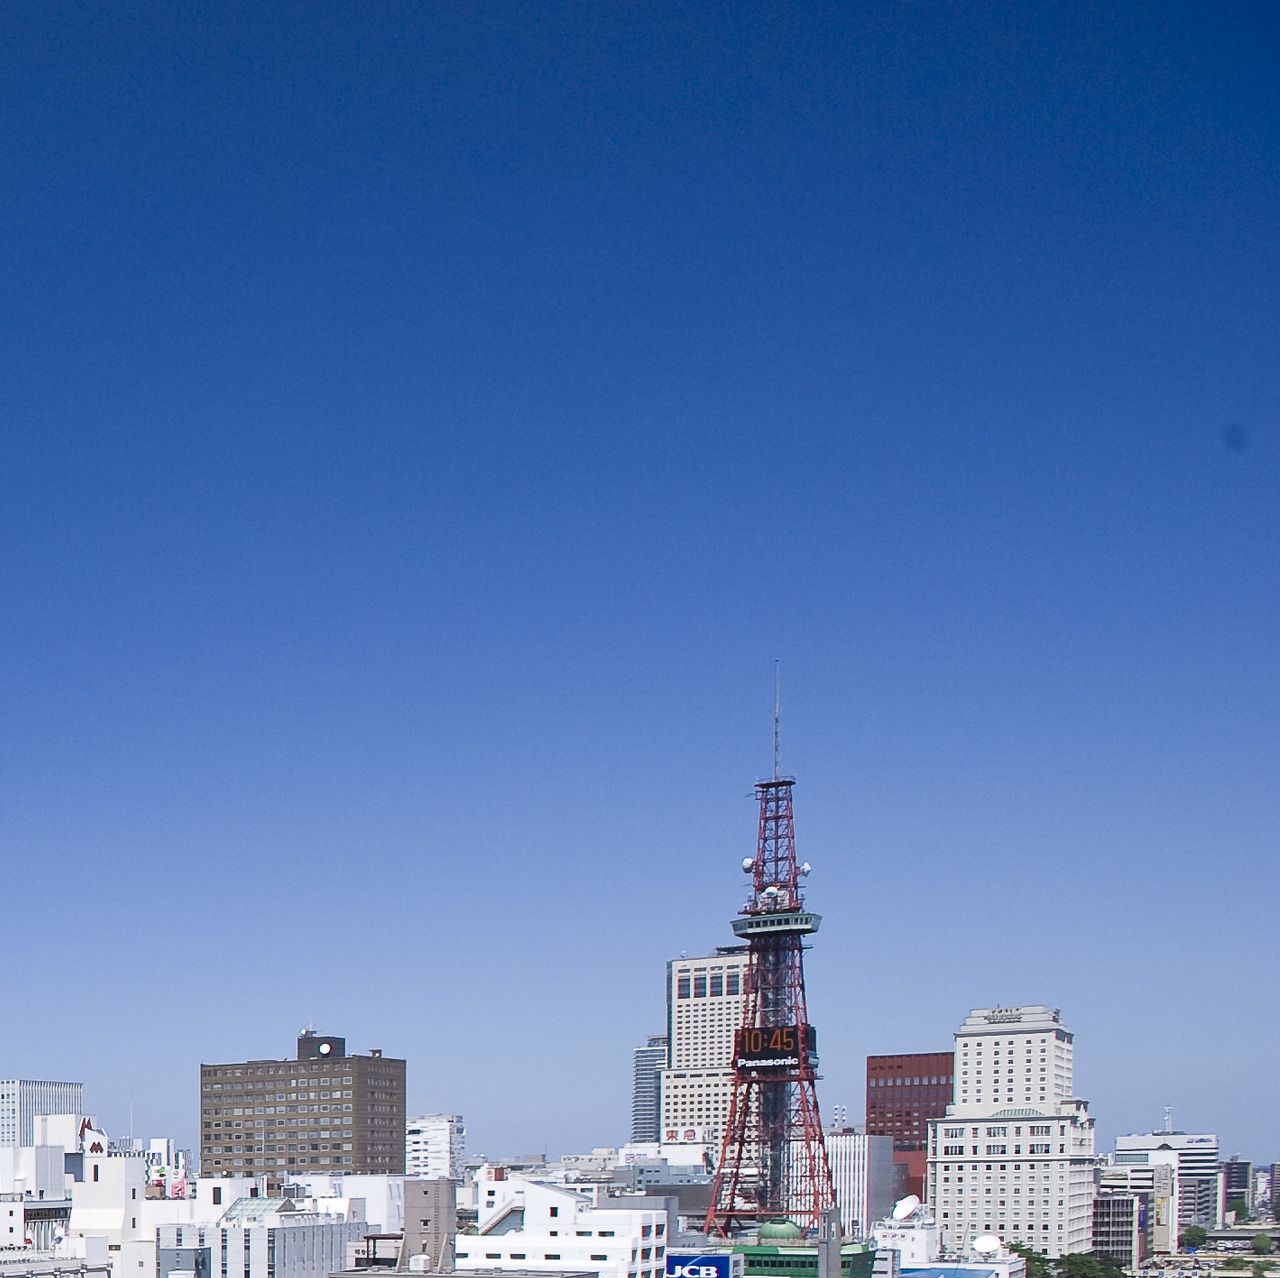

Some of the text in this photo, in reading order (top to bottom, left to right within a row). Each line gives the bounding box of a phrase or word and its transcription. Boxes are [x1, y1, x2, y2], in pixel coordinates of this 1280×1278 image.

[743, 1028, 794, 1053] 10:45
[737, 1056, 799, 1067] Panasonic
[666, 1265, 718, 1278] JCB
